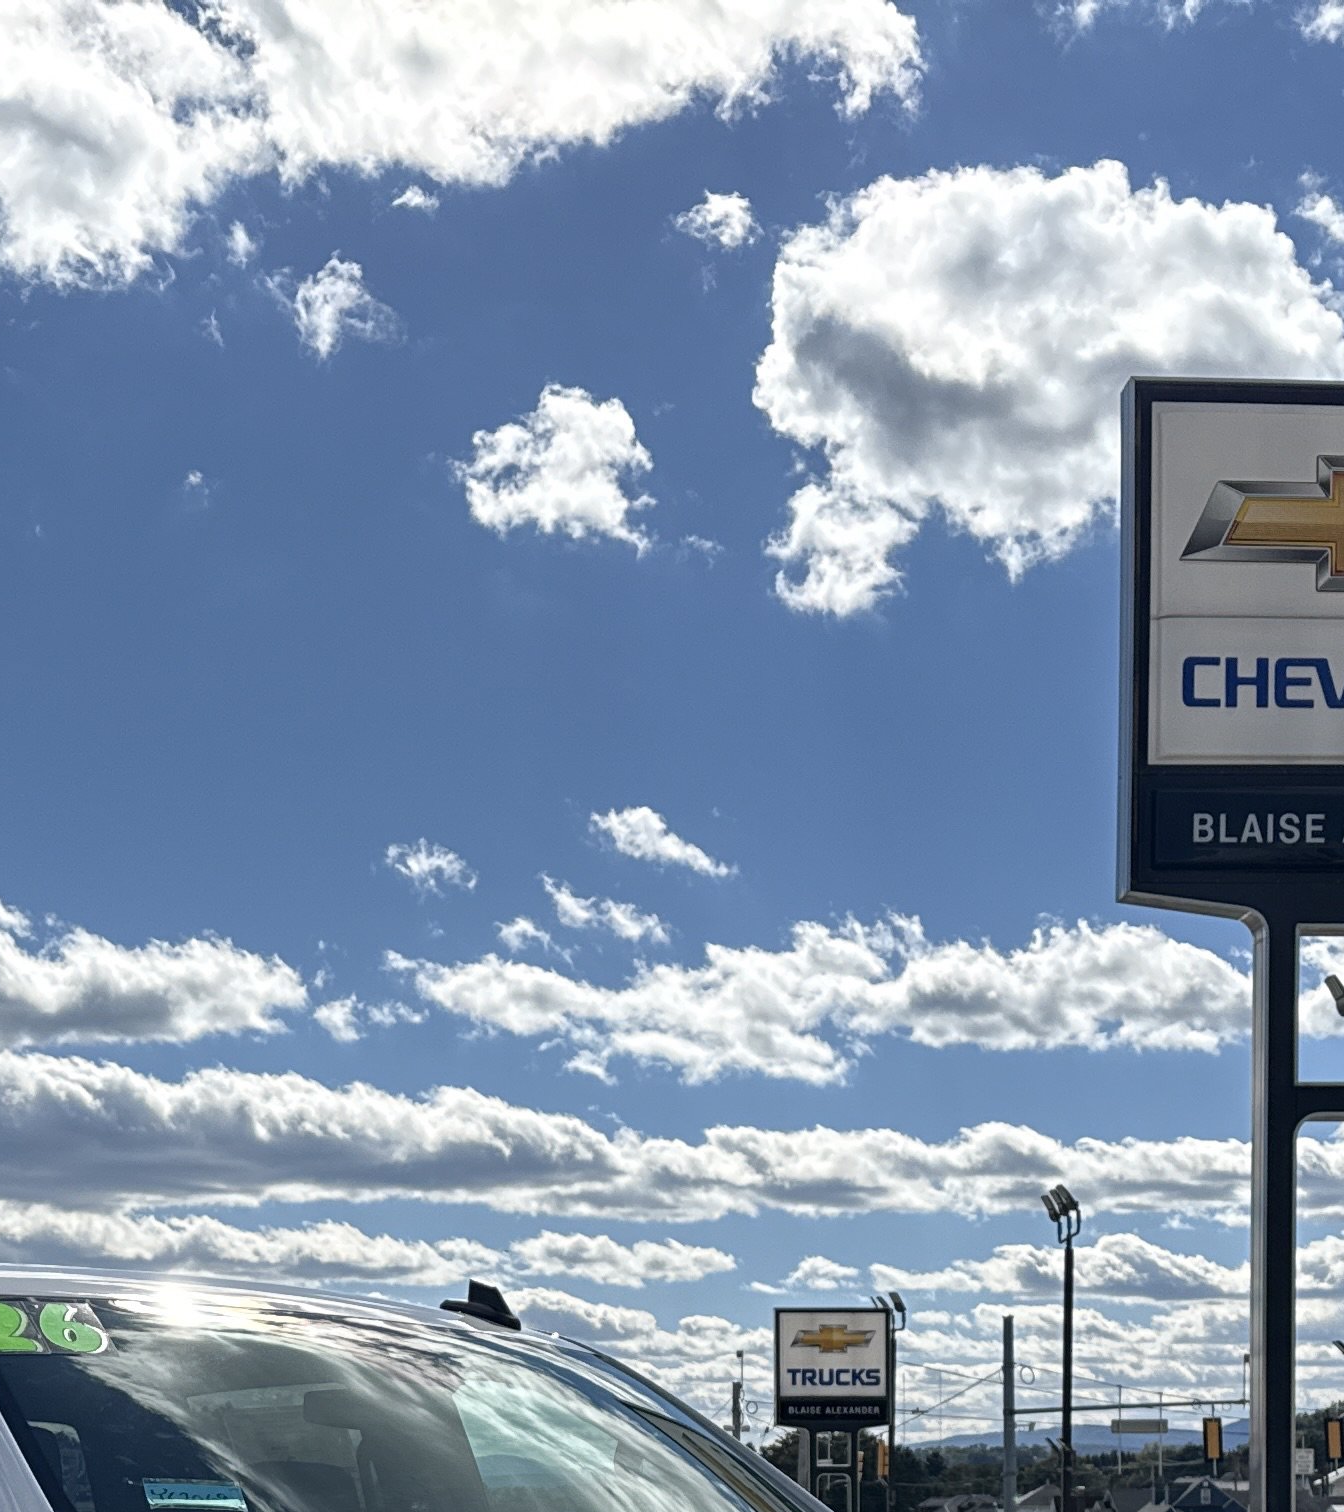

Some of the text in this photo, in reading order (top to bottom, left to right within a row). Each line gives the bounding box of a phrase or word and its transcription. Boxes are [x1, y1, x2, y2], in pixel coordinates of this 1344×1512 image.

[1192, 813, 1326, 844] BLAISE
[787, 1368, 880, 1386] TRUCKS
[788, 1406, 880, 1415] BLAISE ALEXANDER
